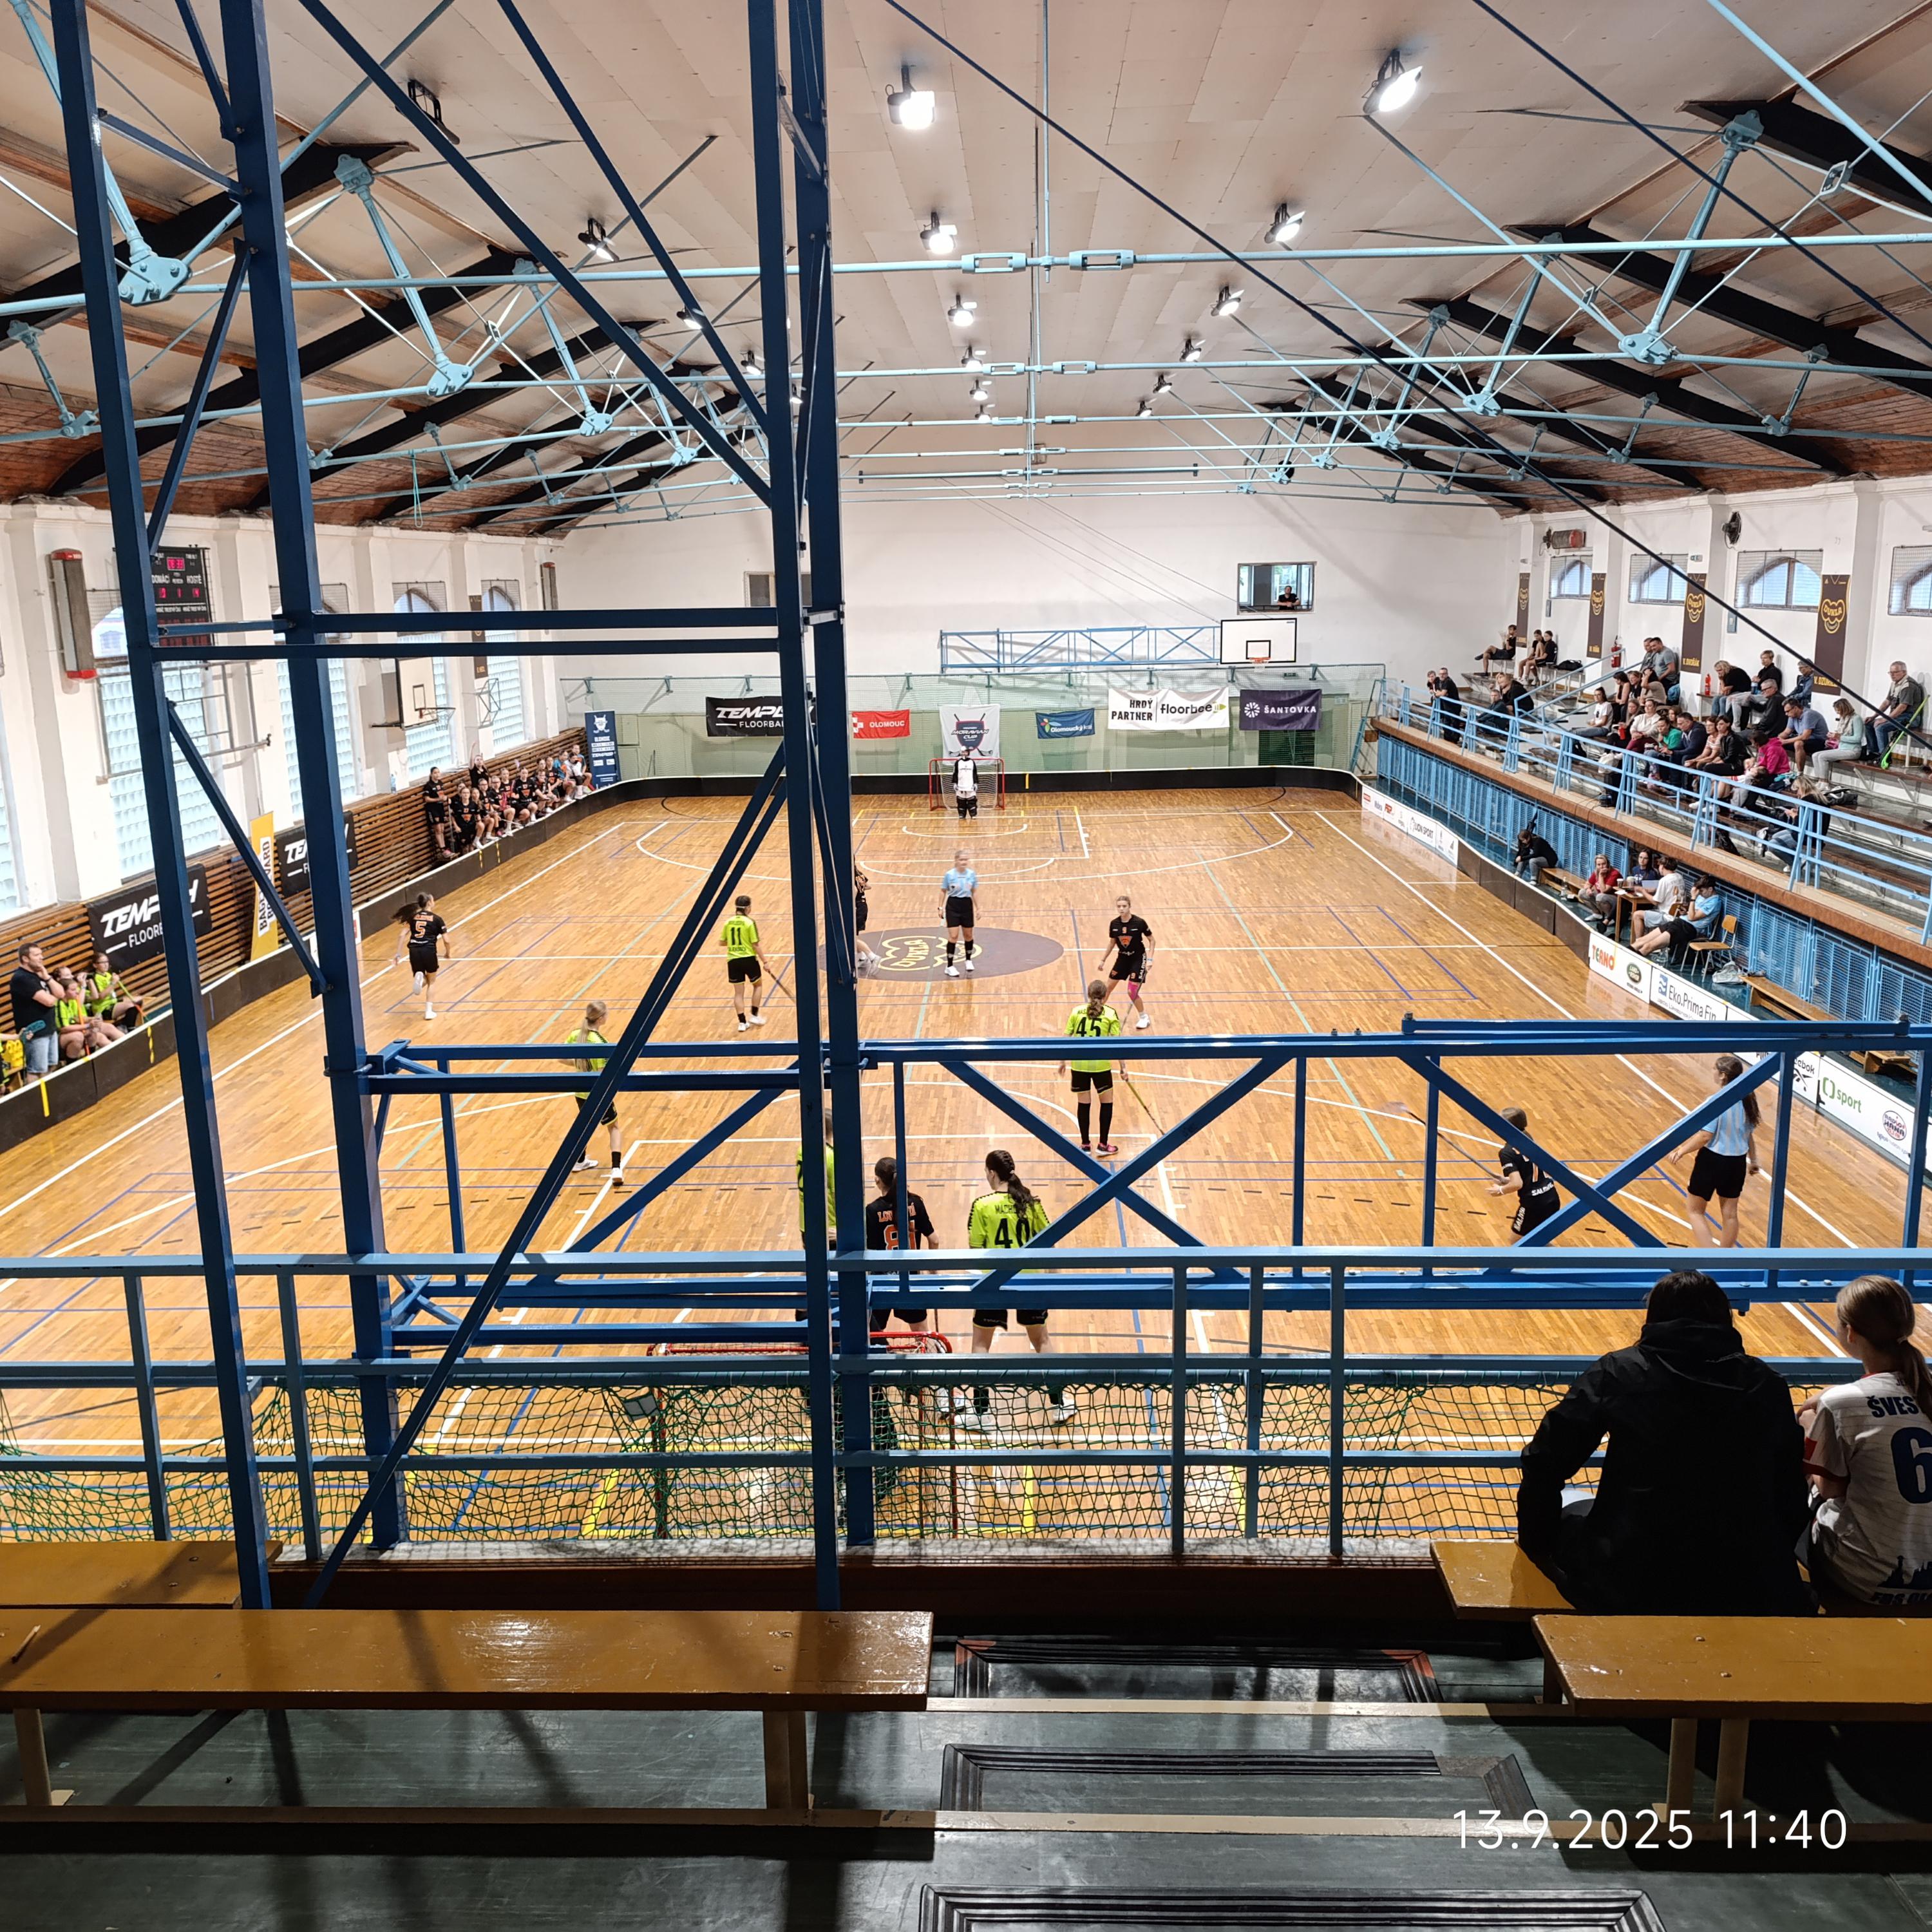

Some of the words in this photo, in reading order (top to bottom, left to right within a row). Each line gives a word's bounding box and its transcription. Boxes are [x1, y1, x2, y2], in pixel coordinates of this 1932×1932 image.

[1823, 604, 1842, 616] DUKLA
[1130, 698, 1153, 708] HRDÝ
[1264, 705, 1316, 714] ŠANTOVKA
[869, 720, 905, 728] OLOMOUC
[1112, 710, 1152, 721] PARTNER
[414, 921, 427, 938] 5
[731, 927, 742, 945] 11
[890, 940, 929, 967] DUKLA
[1592, 945, 1615, 971] TERNO
[1837, 1088, 1862, 1113] sport
[994, 1218, 1030, 1249] 40
[1867, 1395, 1919, 1418] ŠVES
